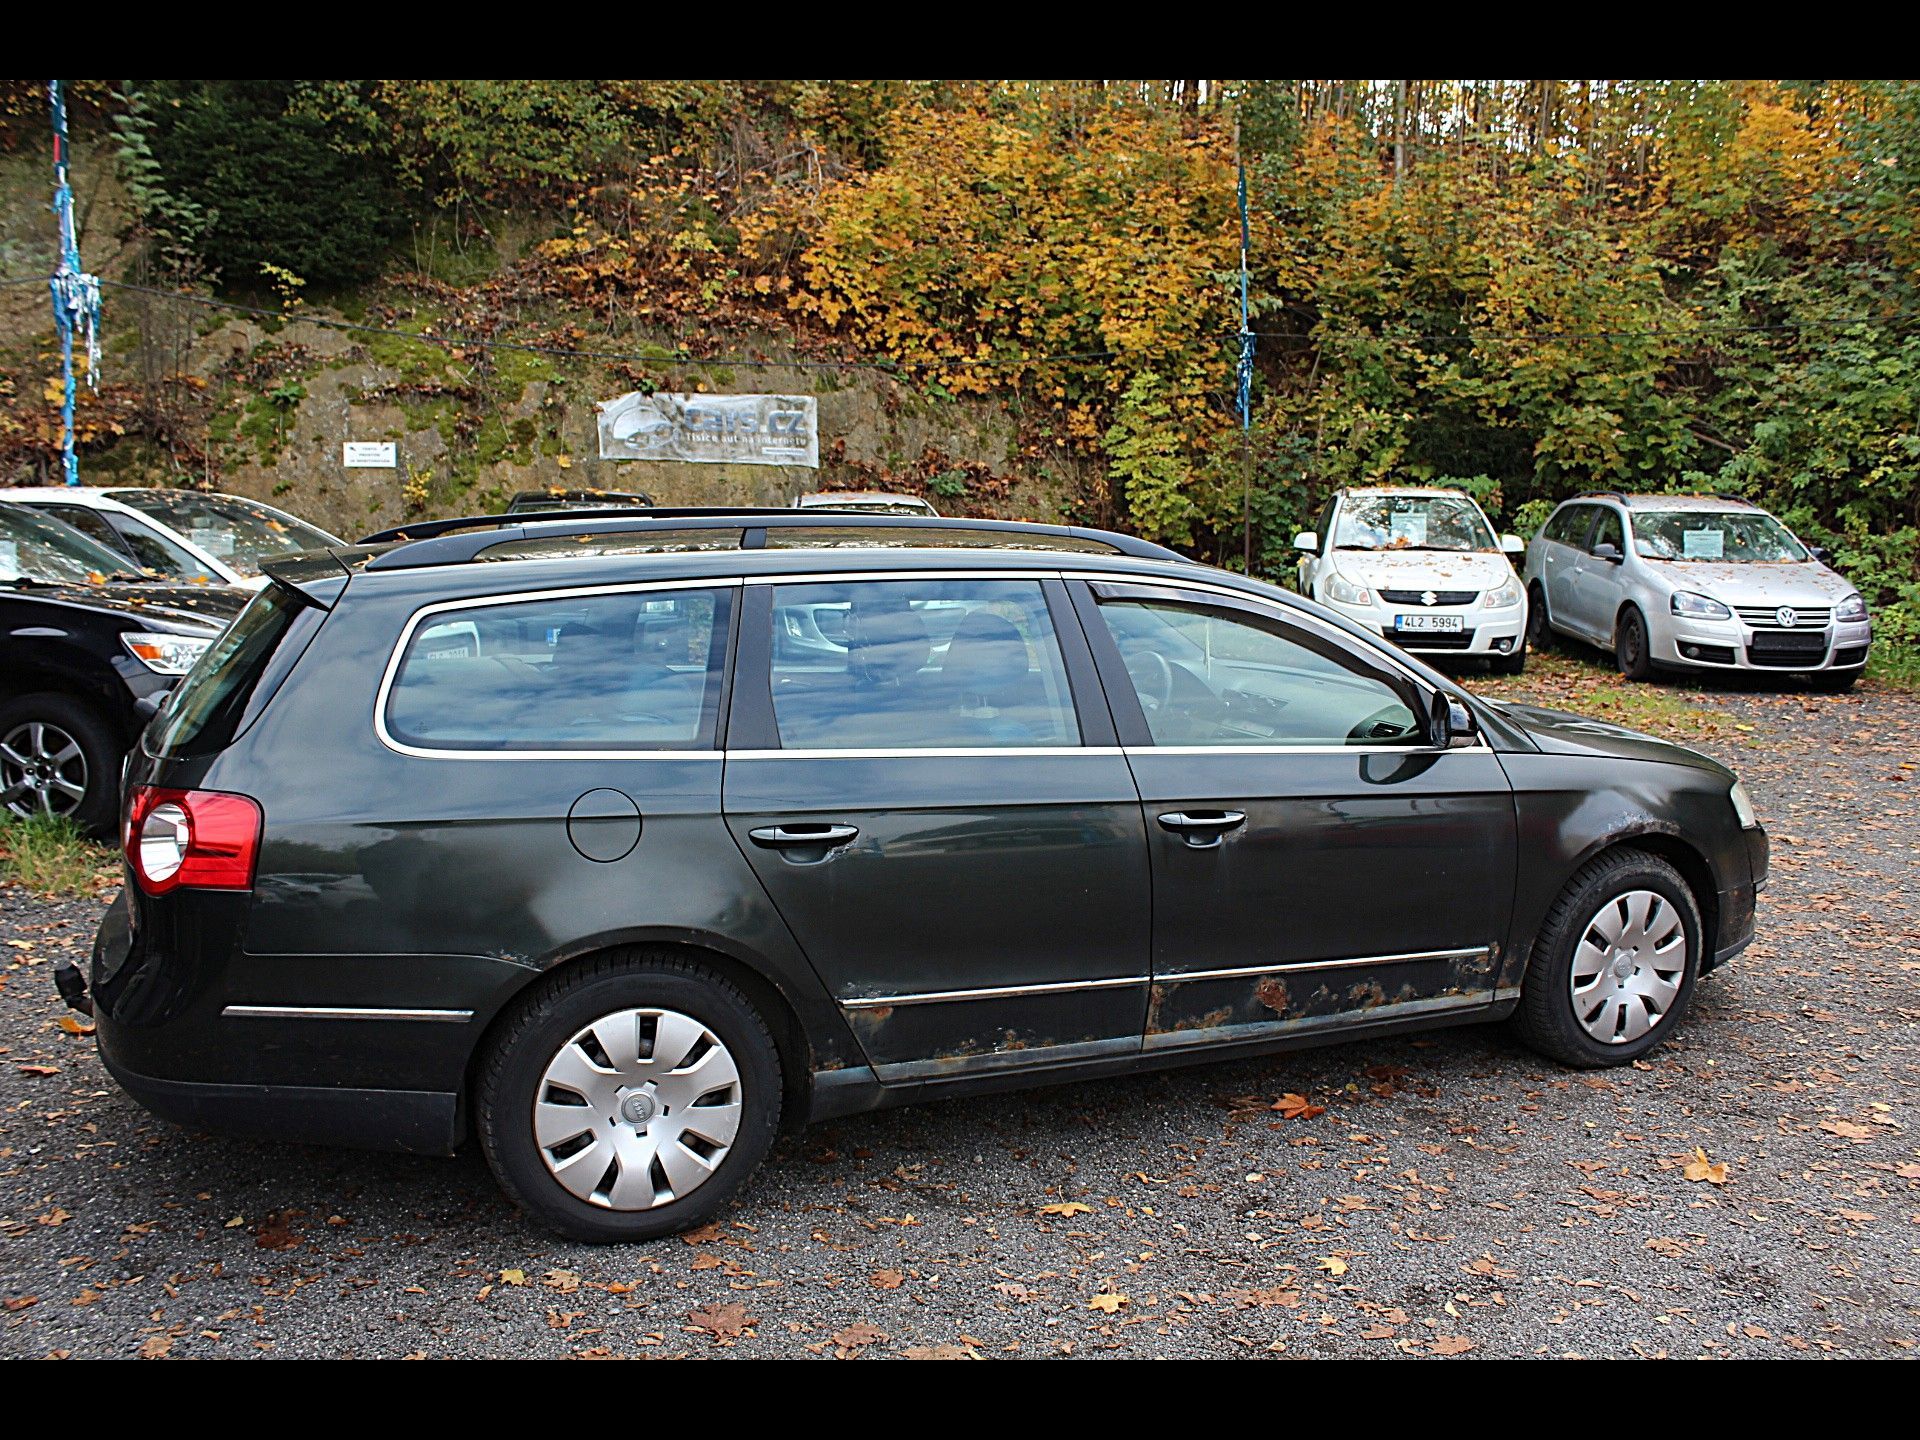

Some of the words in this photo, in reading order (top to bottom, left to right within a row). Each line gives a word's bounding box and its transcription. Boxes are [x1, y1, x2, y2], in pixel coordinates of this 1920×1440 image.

[684, 408, 806, 434] cars.cz
[1405, 617, 1424, 628] 4L2
[1432, 617, 1457, 628] 5994
